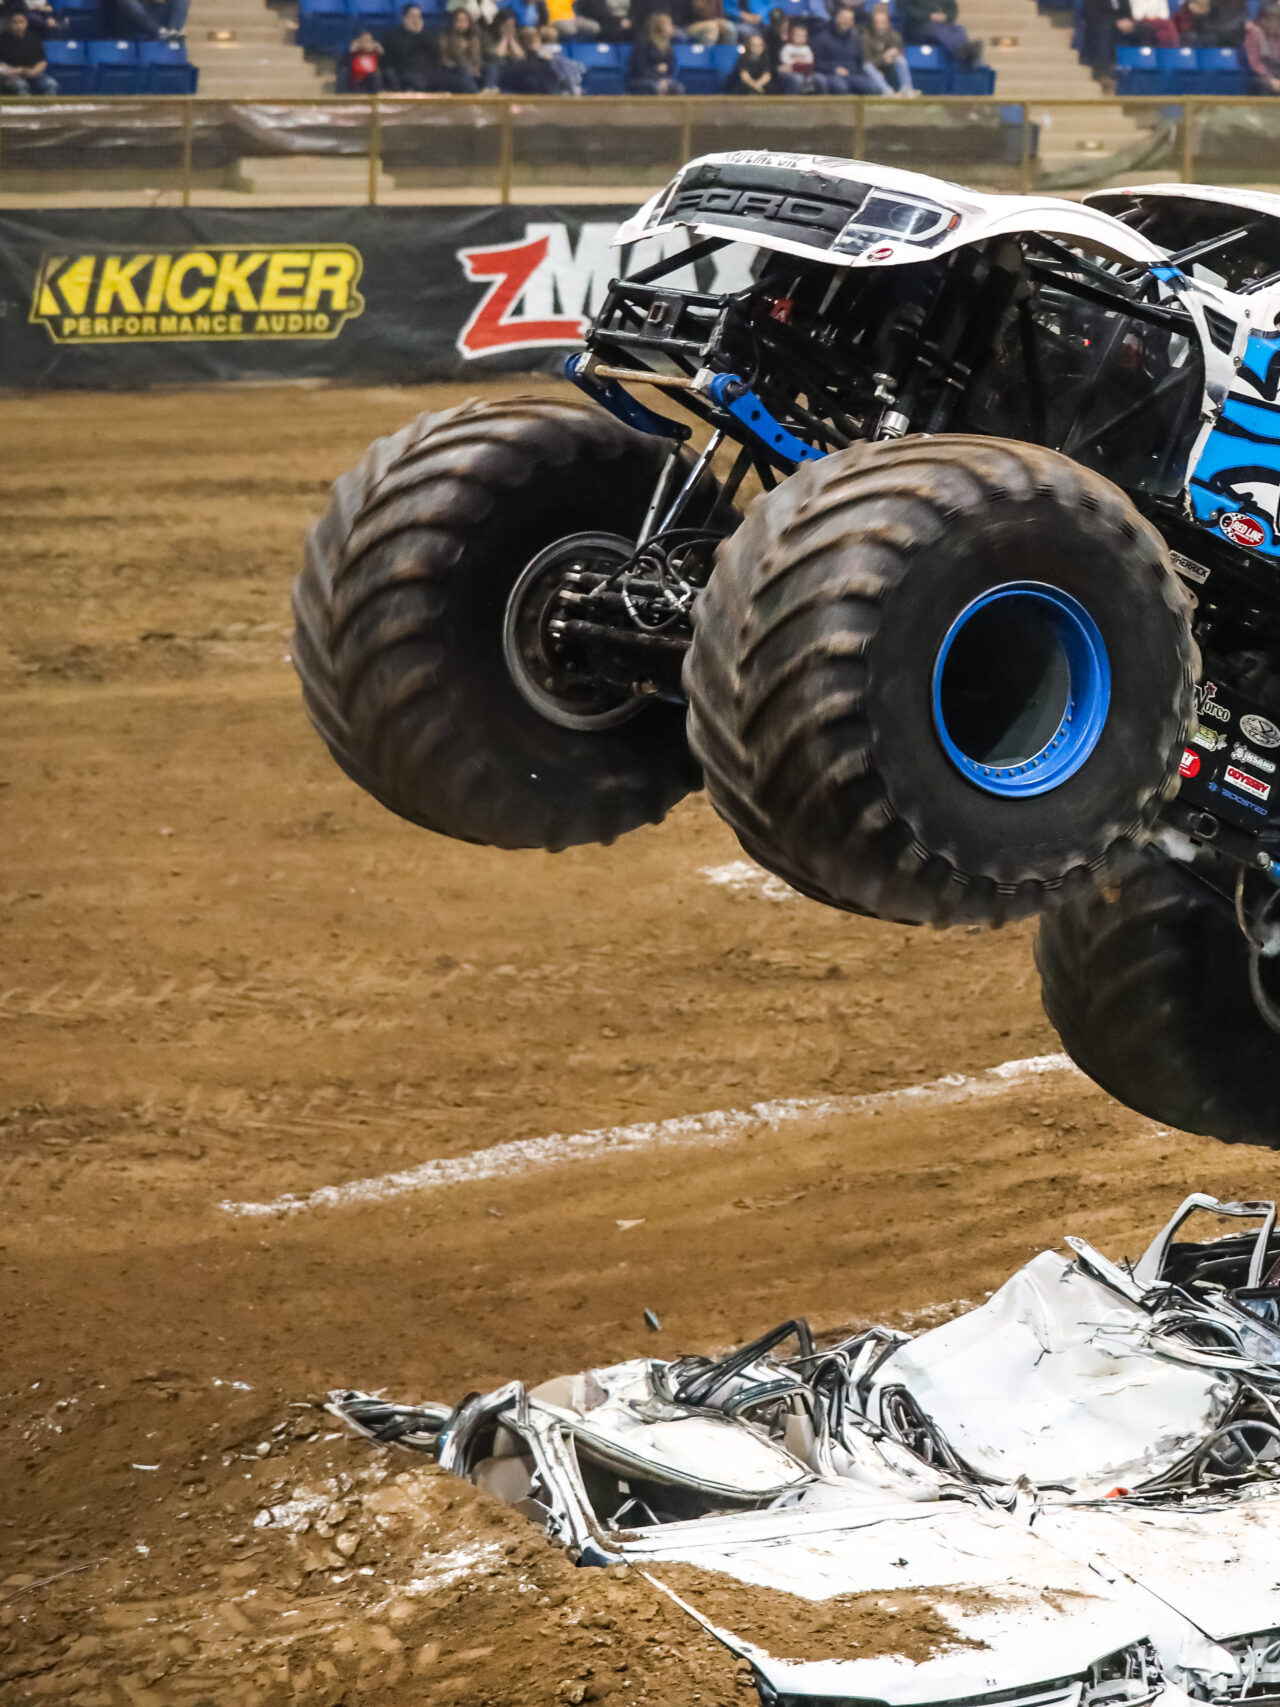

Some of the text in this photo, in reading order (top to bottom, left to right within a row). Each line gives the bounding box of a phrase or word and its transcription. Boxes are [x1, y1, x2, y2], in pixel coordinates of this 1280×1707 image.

[664, 187, 852, 233] FORD
[96, 252, 355, 315] KICKER
[62, 312, 330, 336] PERFORMANCE AUDIO
[1232, 520, 1249, 534] RED
[1246, 527, 1265, 543] LINE
[1194, 684, 1230, 722] Norco
[1227, 767, 1270, 793] ODYSSEY
